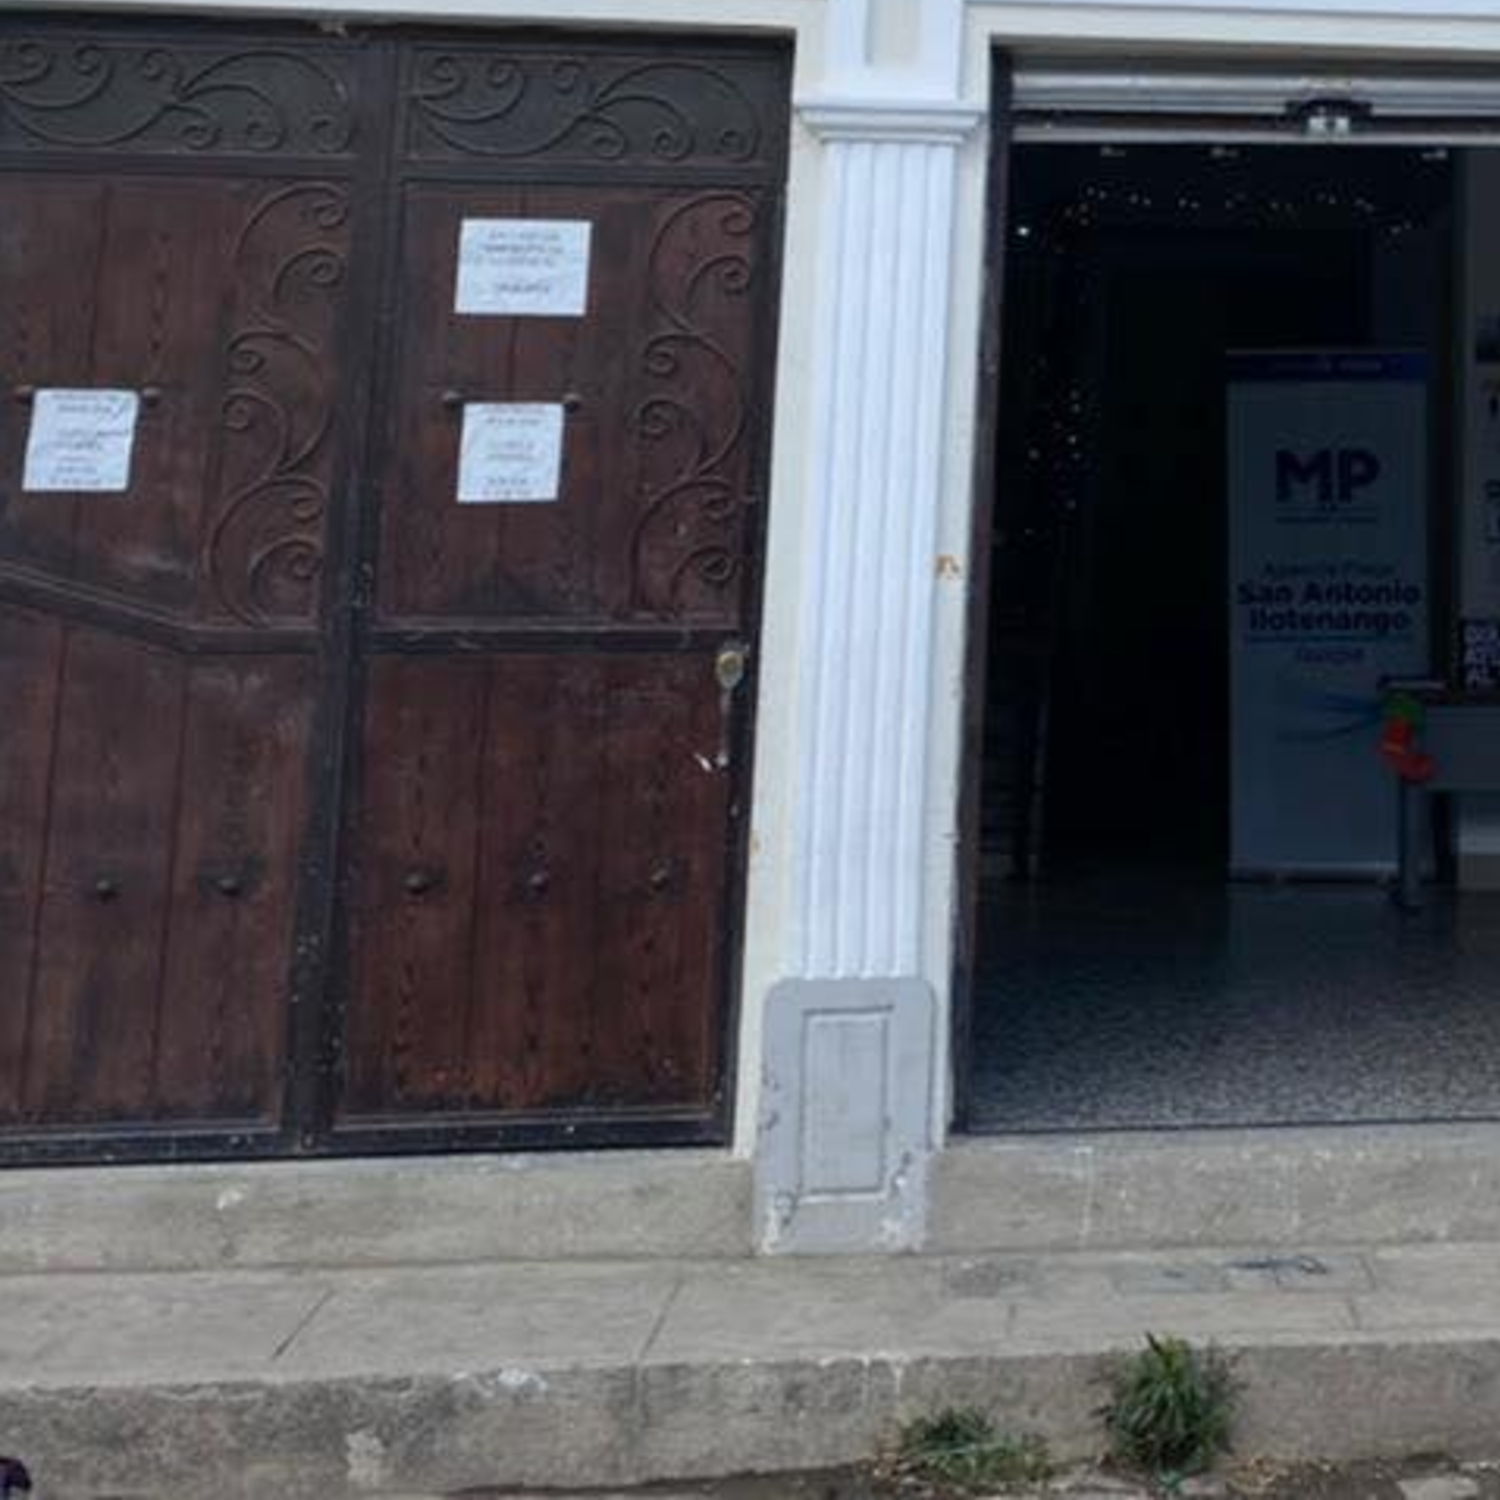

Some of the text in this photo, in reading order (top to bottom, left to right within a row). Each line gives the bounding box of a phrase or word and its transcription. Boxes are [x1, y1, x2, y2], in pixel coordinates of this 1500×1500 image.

[1275, 448, 1380, 503] MP
[1237, 578, 1420, 605] San Antonio
